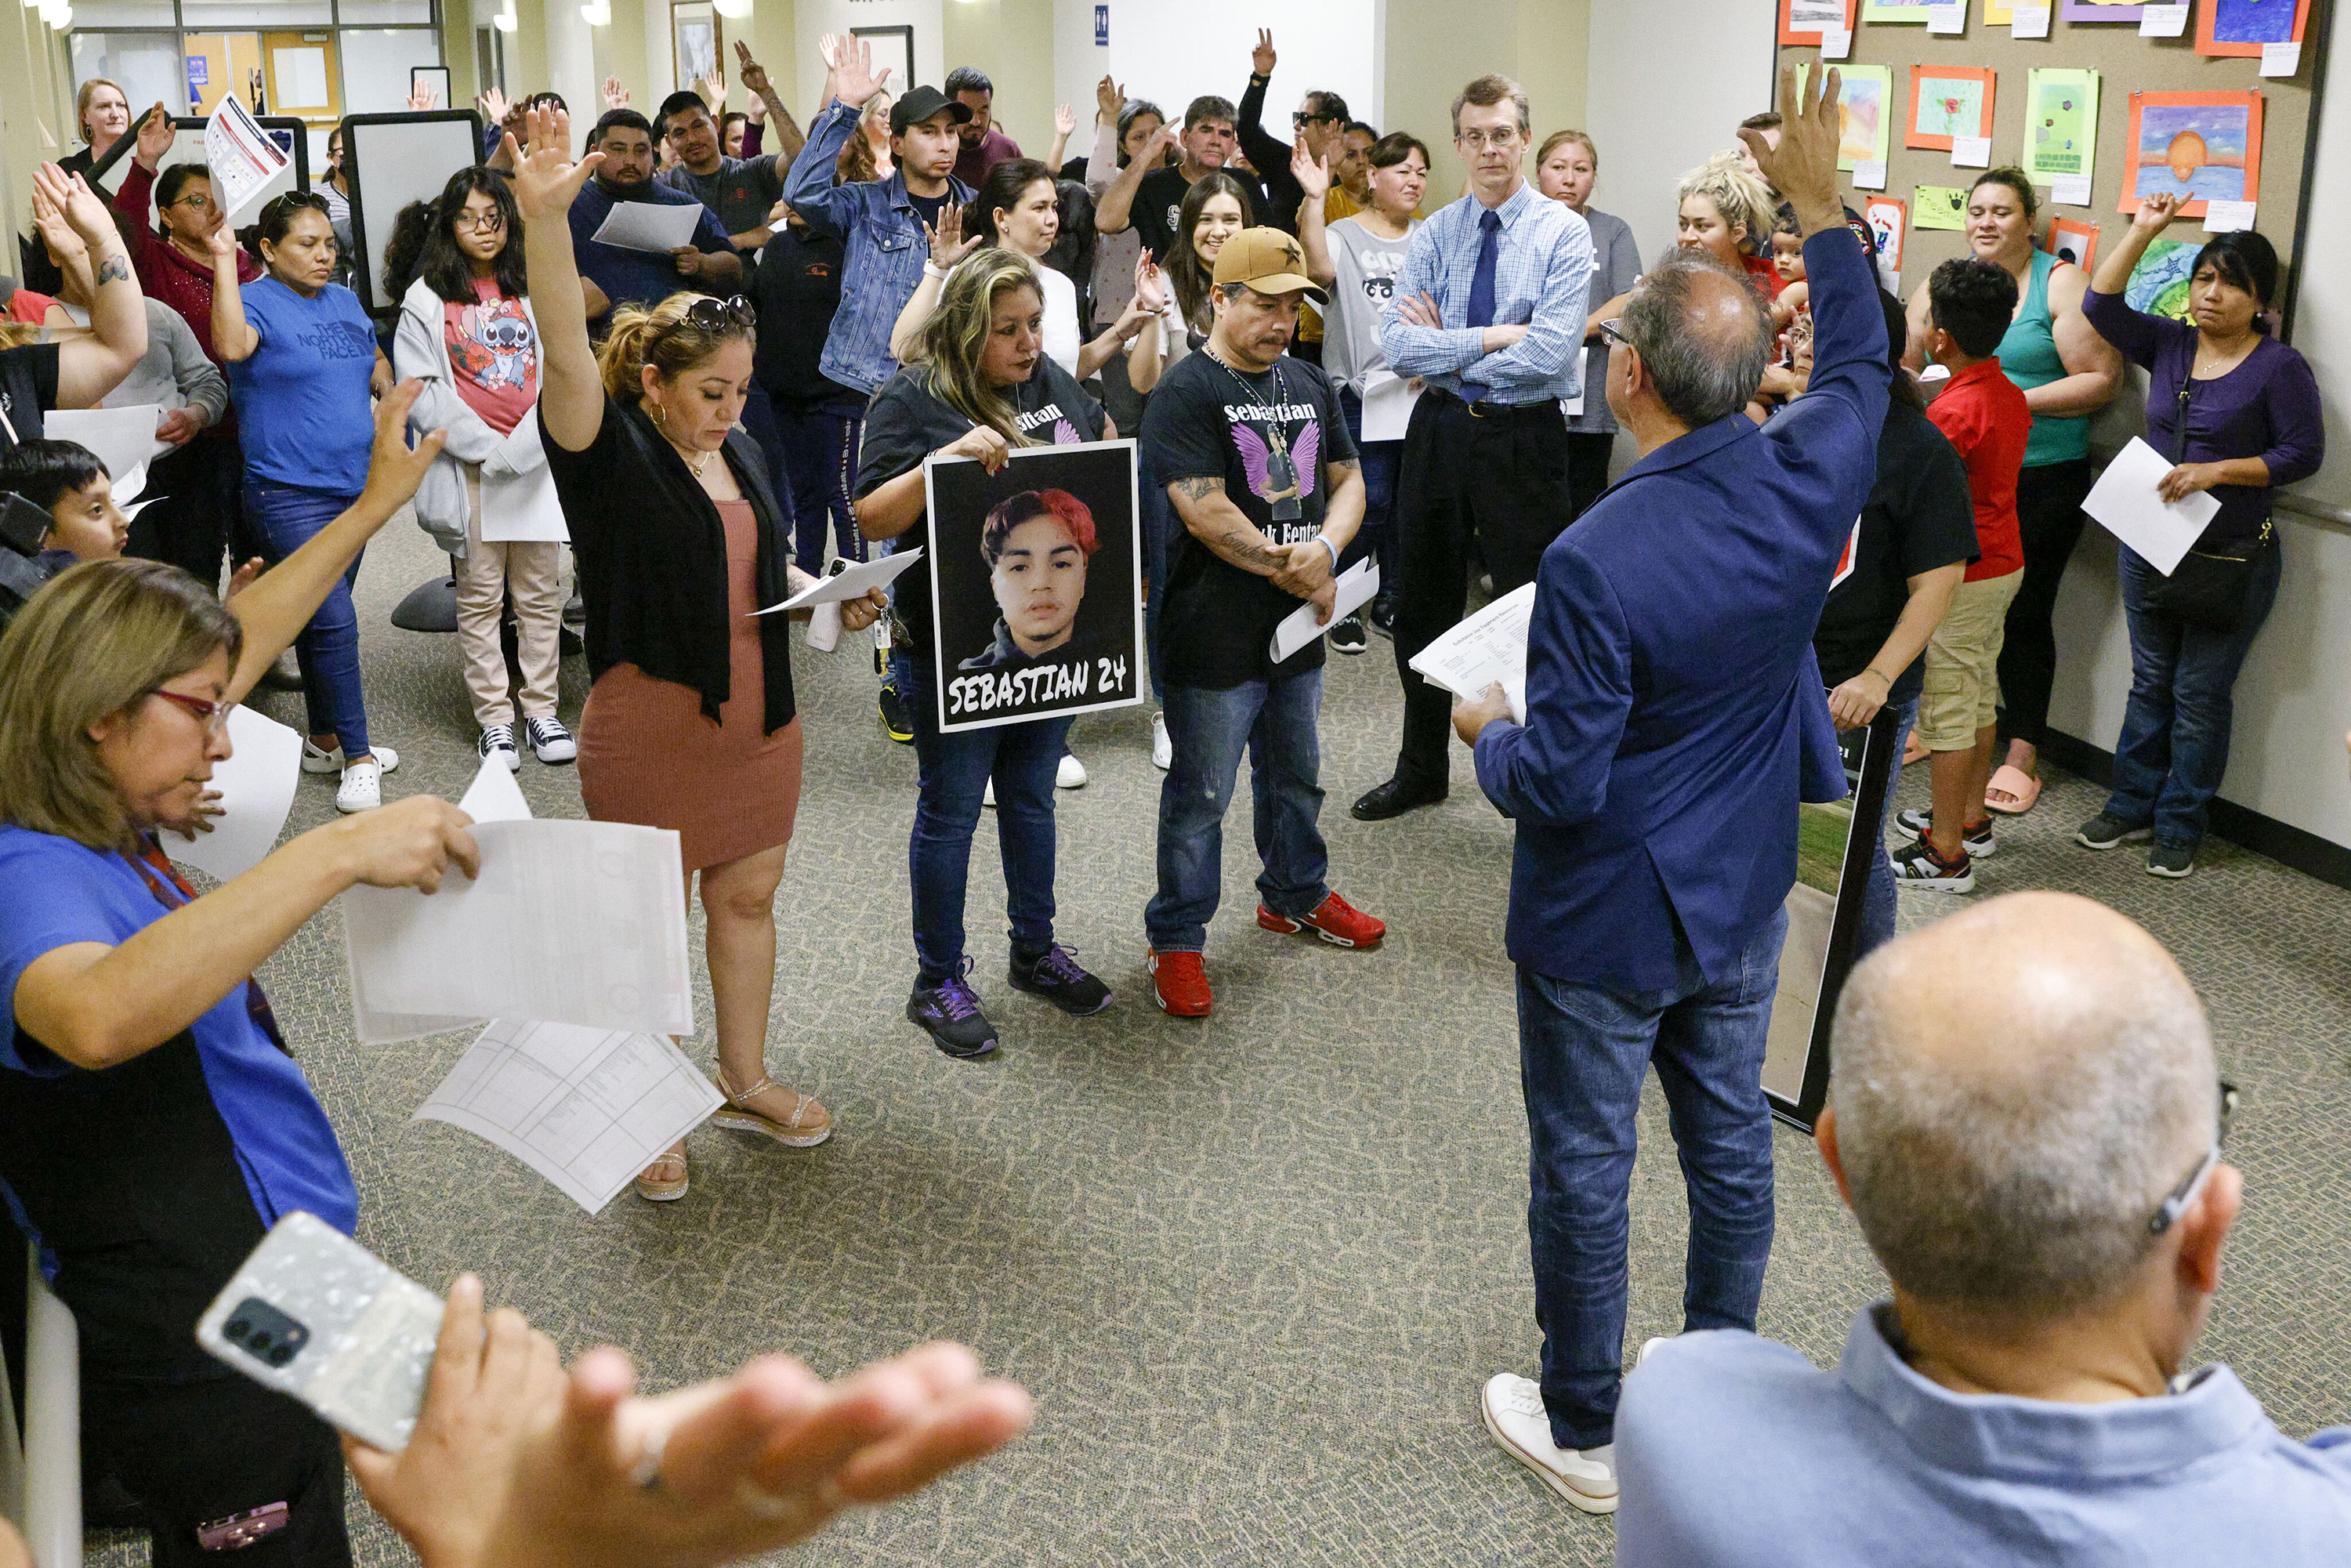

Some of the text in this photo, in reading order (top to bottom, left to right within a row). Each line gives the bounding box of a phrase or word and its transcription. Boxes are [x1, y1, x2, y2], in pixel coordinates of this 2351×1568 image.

[311, 322, 344, 335] THE
[297, 333, 353, 347] NORTH
[318, 345, 360, 360] FACE
[1223, 403, 1317, 422] Sebastian
[1452, 632, 1473, 646] Substance
[1480, 614, 1500, 630] Treatment
[1498, 603, 1520, 618] Resources
[948, 654, 1127, 715] SEBASTIAN 24
